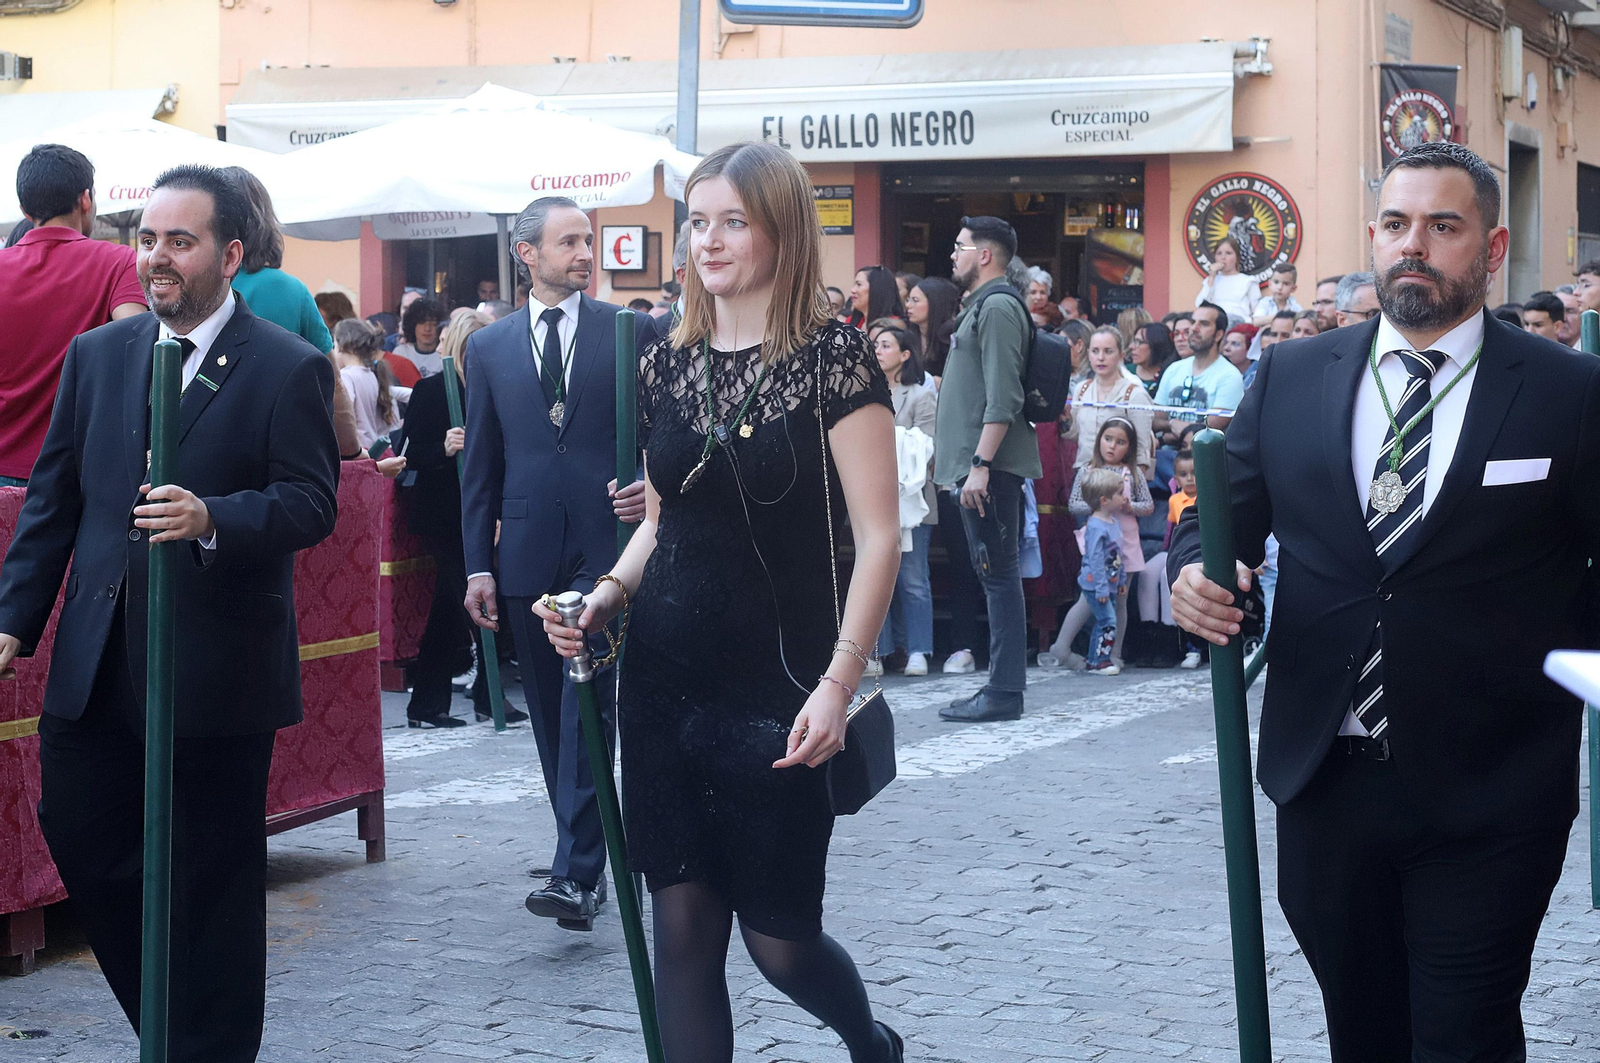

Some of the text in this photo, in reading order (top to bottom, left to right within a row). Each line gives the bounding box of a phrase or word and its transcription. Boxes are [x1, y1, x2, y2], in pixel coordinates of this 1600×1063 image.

[1386, 92, 1448, 118] EL GALLO NEGRO
[1051, 109, 1149, 126] Cruzcampo
[290, 130, 358, 145] Cruzcam
[762, 110, 974, 149] EL GALLO NEGRO
[1065, 129, 1134, 143] ESPECIAL
[531, 171, 631, 190] Cruzcampo
[567, 192, 607, 203] PECIAL
[1194, 178, 1288, 213] EL GALLO NEGRO
